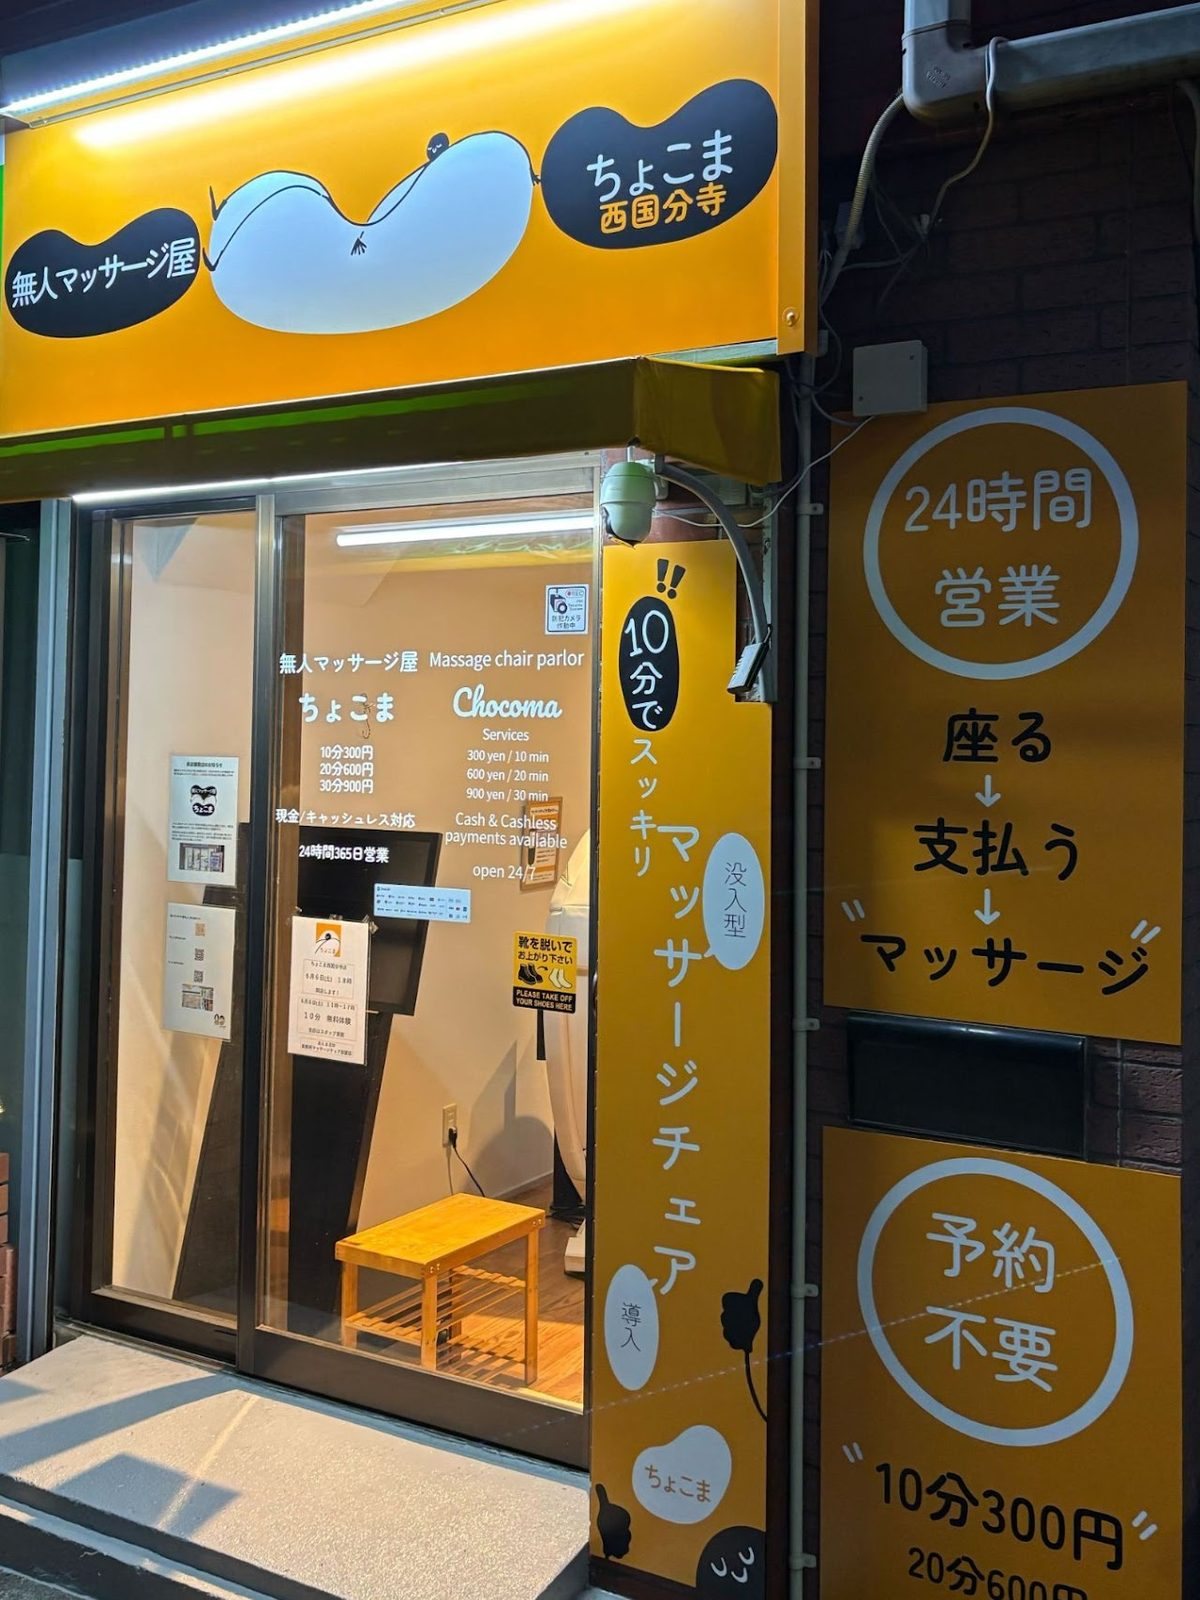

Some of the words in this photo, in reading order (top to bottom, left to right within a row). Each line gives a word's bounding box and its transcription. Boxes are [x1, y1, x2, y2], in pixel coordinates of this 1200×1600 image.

[586, 129, 733, 203] ちょこま
[600, 182, 727, 234] 西国分寺
[12, 237, 197, 308] 無人マッサージ屋
[903, 467, 1094, 534] 24時間
[934, 562, 1061, 628] 営業
[279, 651, 418, 674] 無人マッサージ屋
[429, 652, 491, 672] Massage
[495, 650, 533, 667] chair
[537, 648, 585, 671] parlor
[298, 692, 394, 723] ちょこま
[452, 683, 563, 718] Chocoma
[482, 727, 530, 742] Services
[942, 707, 1053, 764] 座る
[320, 744, 374, 761] 10分300円
[466, 749, 486, 761] 300
[487, 752, 506, 764] yen
[515, 751, 527, 762] 10
[528, 751, 550, 763] min
[319, 761, 374, 778] 20分600円
[466, 768, 485, 780] 600
[487, 771, 506, 782] yen
[514, 769, 527, 782] 20
[528, 769, 549, 782] min
[319, 778, 374, 794] 30分900円
[466, 787, 485, 799] 900
[486, 790, 505, 802] yen
[513, 789, 526, 801] 30
[528, 790, 549, 802] min
[275, 808, 416, 829] 現金/キャッシュレス対応
[455, 812, 486, 826] Cash
[488, 813, 498, 828] &
[500, 813, 557, 831] Cashless
[445, 830, 507, 847] payments
[509, 832, 568, 849] available
[913, 816, 1079, 881] 支払う
[298, 843, 390, 864] 24時間365日営業
[472, 865, 505, 881] open
[508, 864, 536, 884] 24/7
[723, 862, 748, 939] 没入型
[518, 936, 573, 954] 靴を脱いで
[517, 951, 573, 965] お上がり下さい
[859, 933, 1150, 996] マッサージ
[516, 989, 541, 998] PLEASE
[542, 992, 559, 1001] TAKE
[560, 994, 573, 1003] OFF
[516, 997, 534, 1006] YOUR
[533, 1000, 555, 1009] SHOES
[555, 1002, 573, 1011] HERE
[652, 824, 702, 1295] マッサージチェア
[926, 1212, 1056, 1293] 予約
[620, 1301, 642, 1353] 導入
[925, 1306, 1059, 1392] 不要
[644, 1463, 712, 1504] ちょこま
[875, 1462, 1124, 1570] 10分300円
